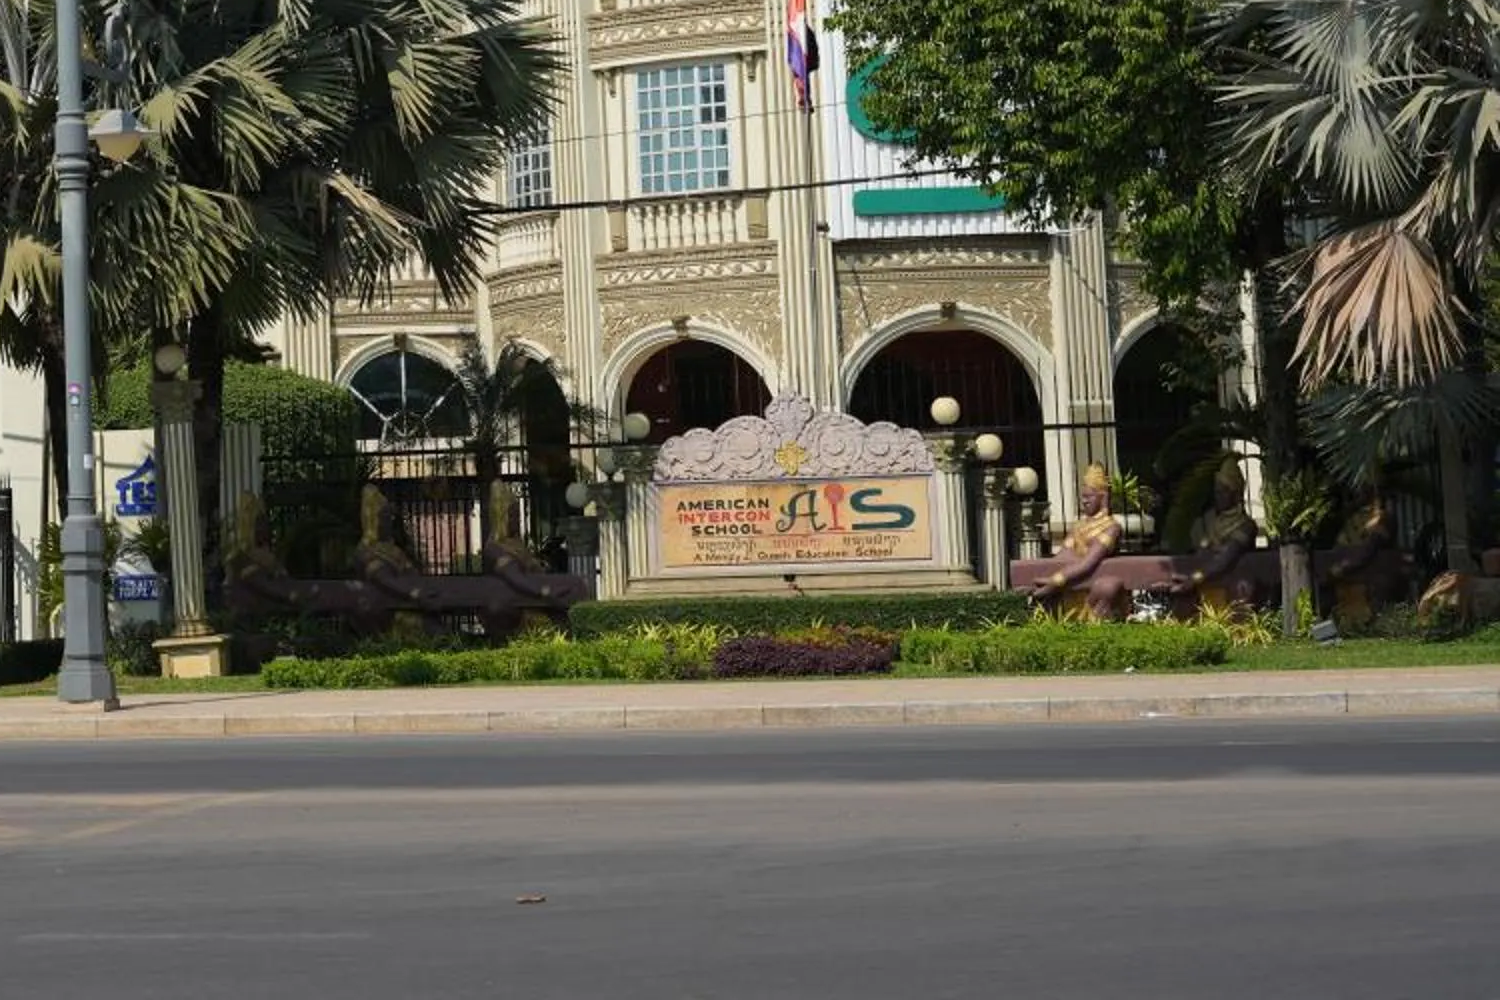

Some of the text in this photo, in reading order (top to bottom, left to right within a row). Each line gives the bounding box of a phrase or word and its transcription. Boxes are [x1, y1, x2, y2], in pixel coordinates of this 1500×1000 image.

[677, 498, 769, 512] AMERICAN
[775, 484, 916, 533] AIS
[678, 510, 771, 524] INTERCON
[691, 524, 763, 537] SCHOOL
